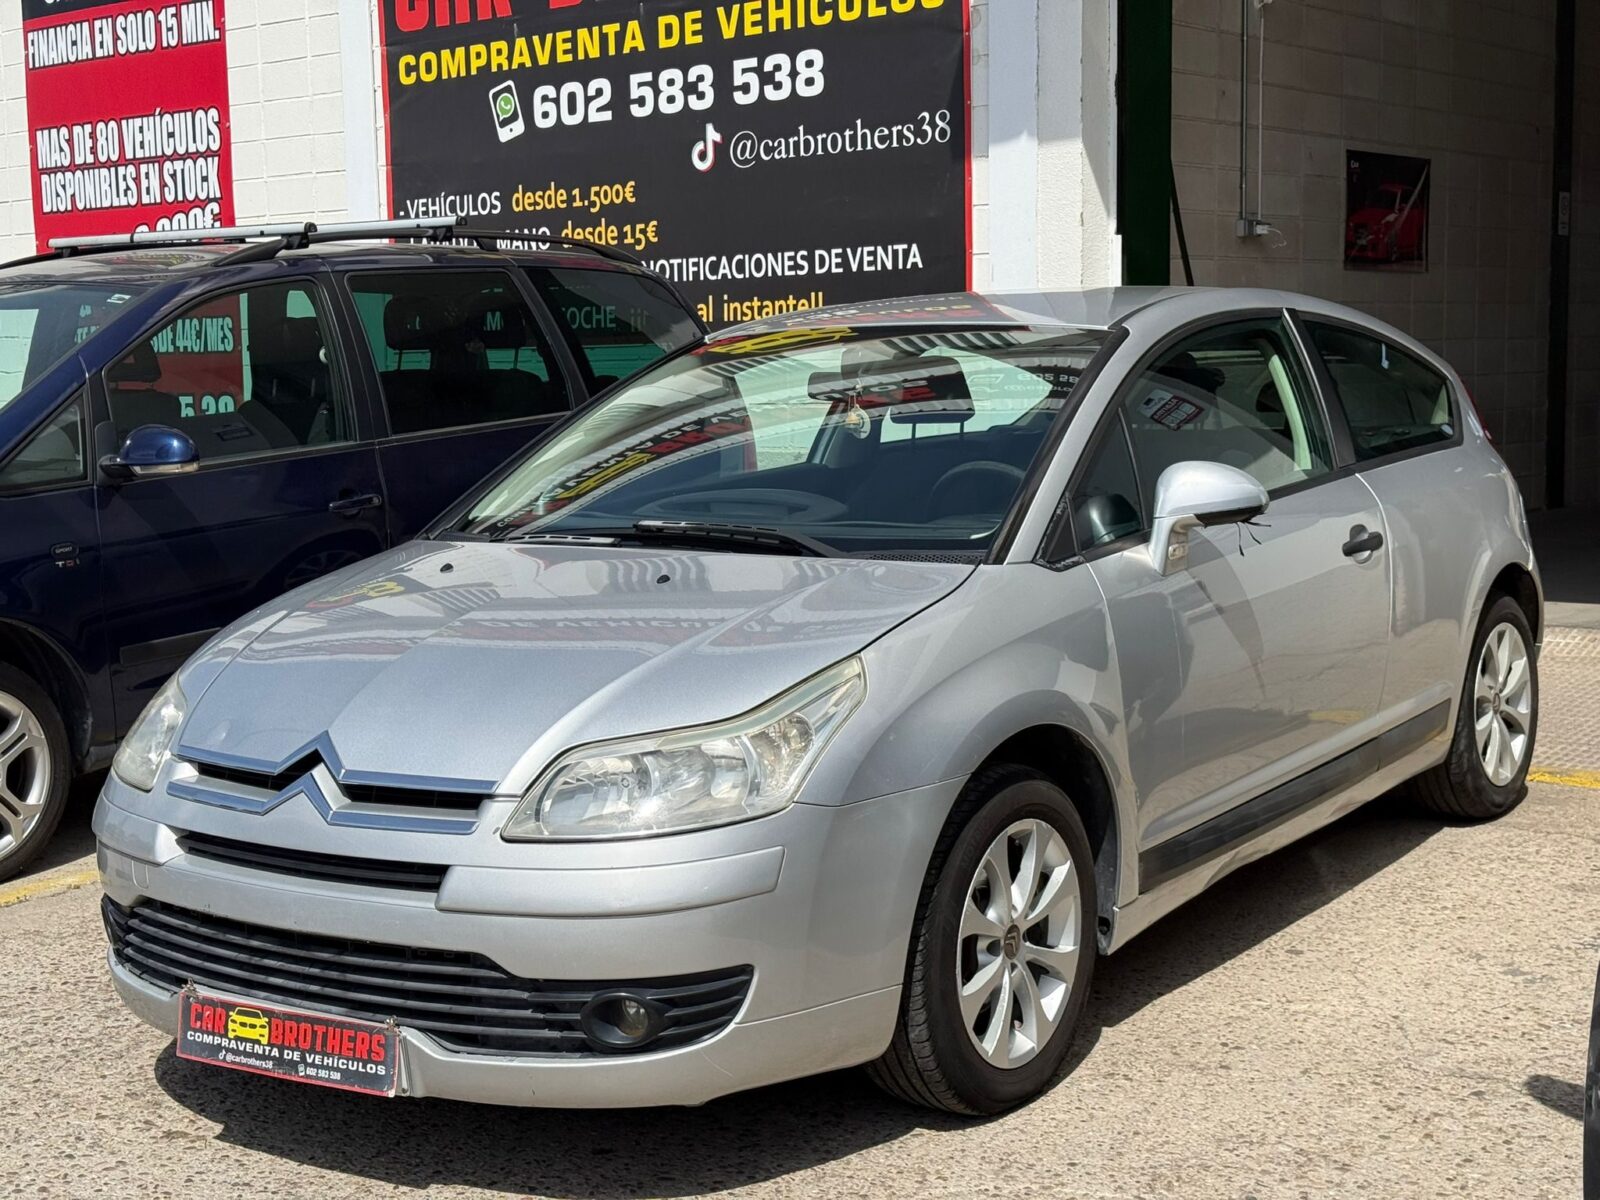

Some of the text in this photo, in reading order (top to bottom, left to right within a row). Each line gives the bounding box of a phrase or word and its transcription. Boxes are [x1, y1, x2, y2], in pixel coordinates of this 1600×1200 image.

[28, 0, 220, 68] FINANCIA EN SOLO 15 MIN.
[398, 20, 645, 85] COMPRAVENTA
[658, 11, 703, 49] DE
[533, 49, 825, 129] 602 583 538
[36, 107, 221, 169] MAS DE 80 VEHÍCULOS
[730, 109, 951, 169] @carbrothers38
[41, 156, 222, 213] DISPONIBLES EN STOCK
[511, 181, 568, 212] desde
[571, 180, 636, 213] 1.500€
[561, 217, 618, 249] desde
[623, 220, 659, 250] 15€
[813, 247, 843, 275] DE
[846, 243, 924, 272] VENTA
[561, 305, 617, 330] OCHE
[697, 295, 713, 322] al
[187, 1031, 386, 1075] COMPRAVENTA DE VEHÍCULOS
[190, 1003, 386, 1062] CAR BROTHERS
[226, 1052, 273, 1069] @carbrothers38
